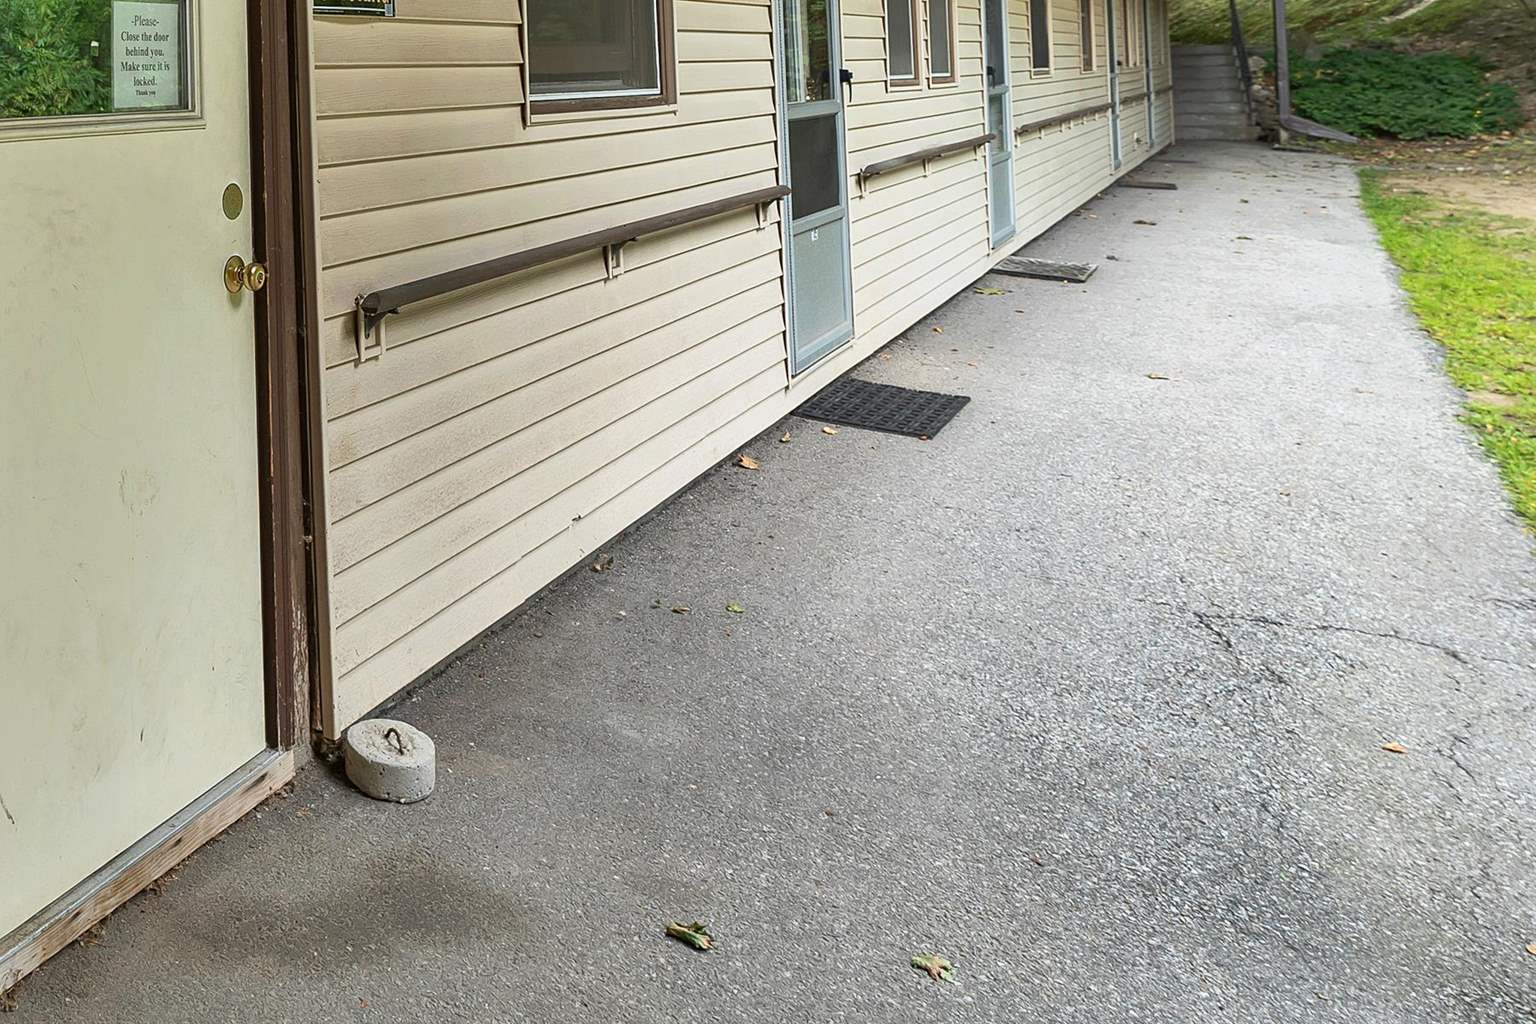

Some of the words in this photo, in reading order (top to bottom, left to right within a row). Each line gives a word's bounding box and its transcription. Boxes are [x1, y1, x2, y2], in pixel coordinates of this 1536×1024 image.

[121, 31, 140, 42] Close
[141, 31, 152, 42] the
[154, 32, 170, 42] door
[126, 46, 149, 57] behind
[150, 47, 164, 59] you.
[121, 62, 140, 72] Make
[141, 63, 156, 72] sure
[157, 61, 163, 71] it
[164, 61, 170, 71] is
[133, 76, 157, 87] locked.
